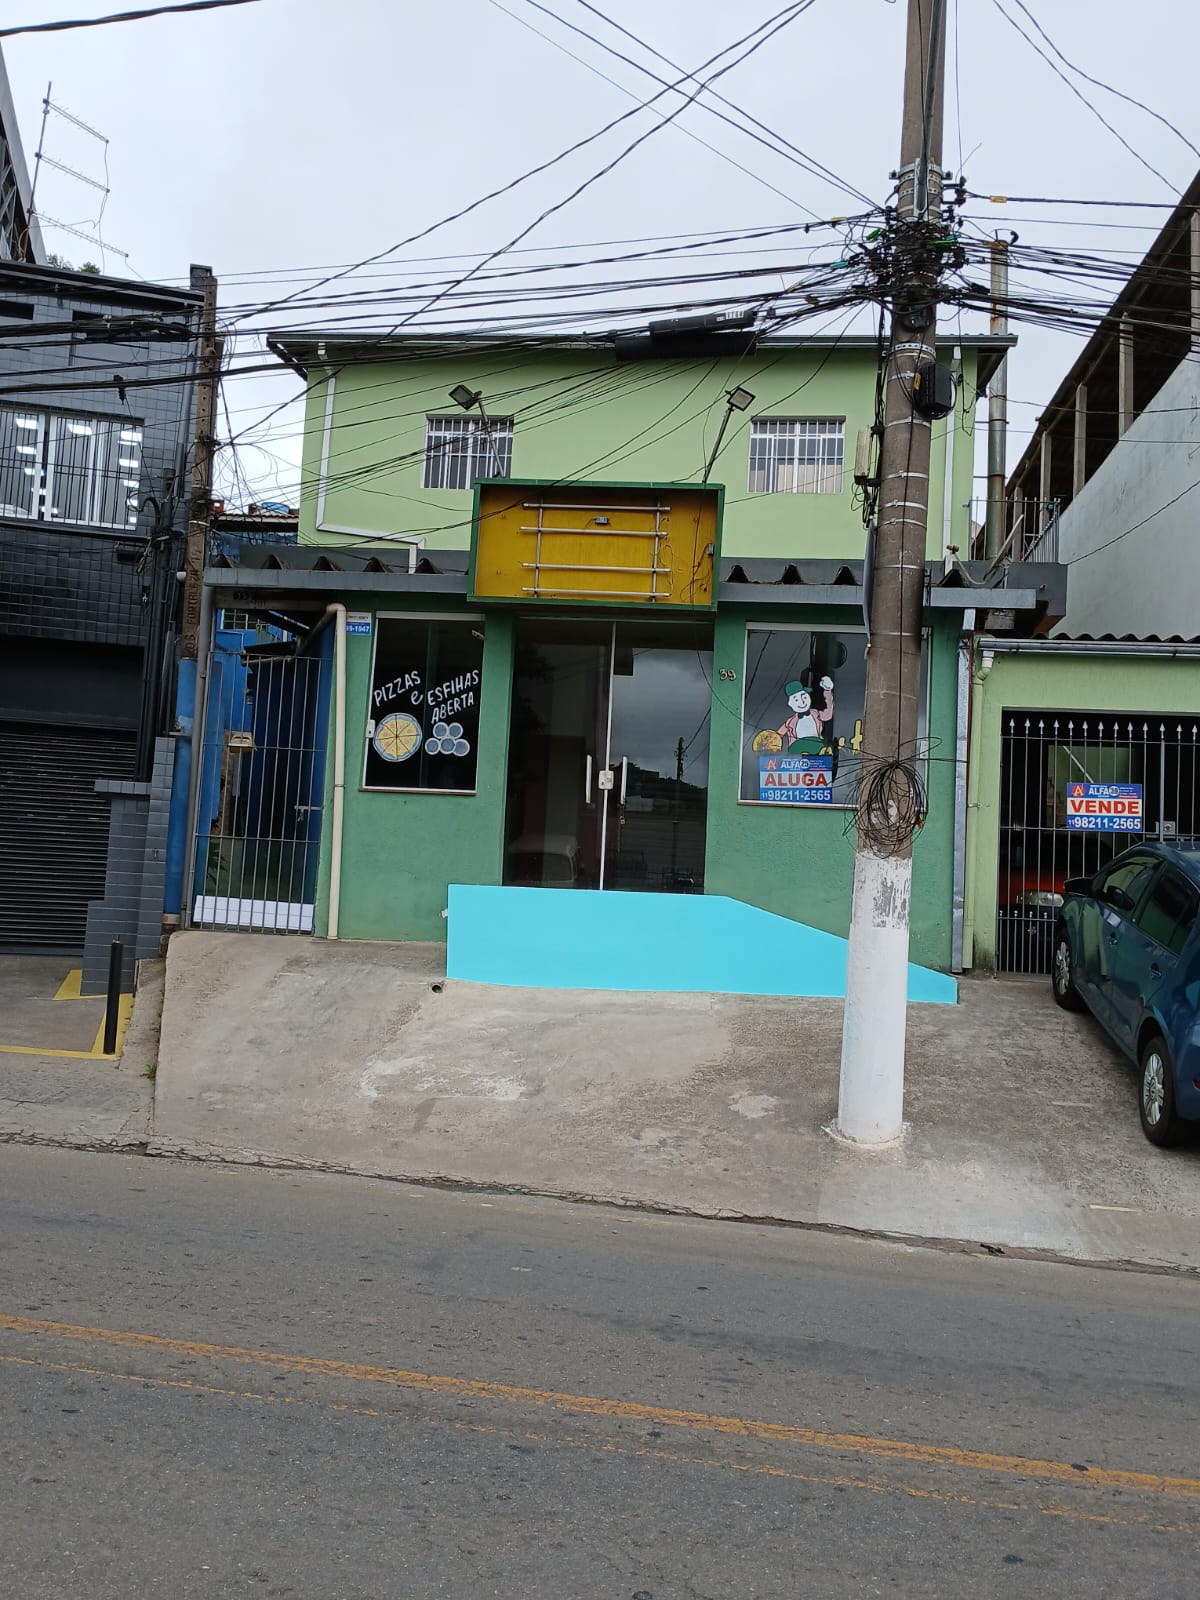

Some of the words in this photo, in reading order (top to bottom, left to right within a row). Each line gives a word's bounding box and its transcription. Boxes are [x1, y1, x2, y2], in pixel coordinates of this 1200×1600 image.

[374, 671, 421, 707] PIZZAS
[411, 690, 424, 705] e
[427, 670, 480, 706] ESFIHAS
[431, 692, 474, 724] ABERTA
[780, 760, 801, 769] ALFA
[764, 773, 829, 787] ALUGA
[768, 790, 831, 801] 98211-2565
[1088, 787, 1109, 796] ALFA
[1070, 799, 1140, 815] VENDE
[1074, 816, 1141, 829] 98211-2565
